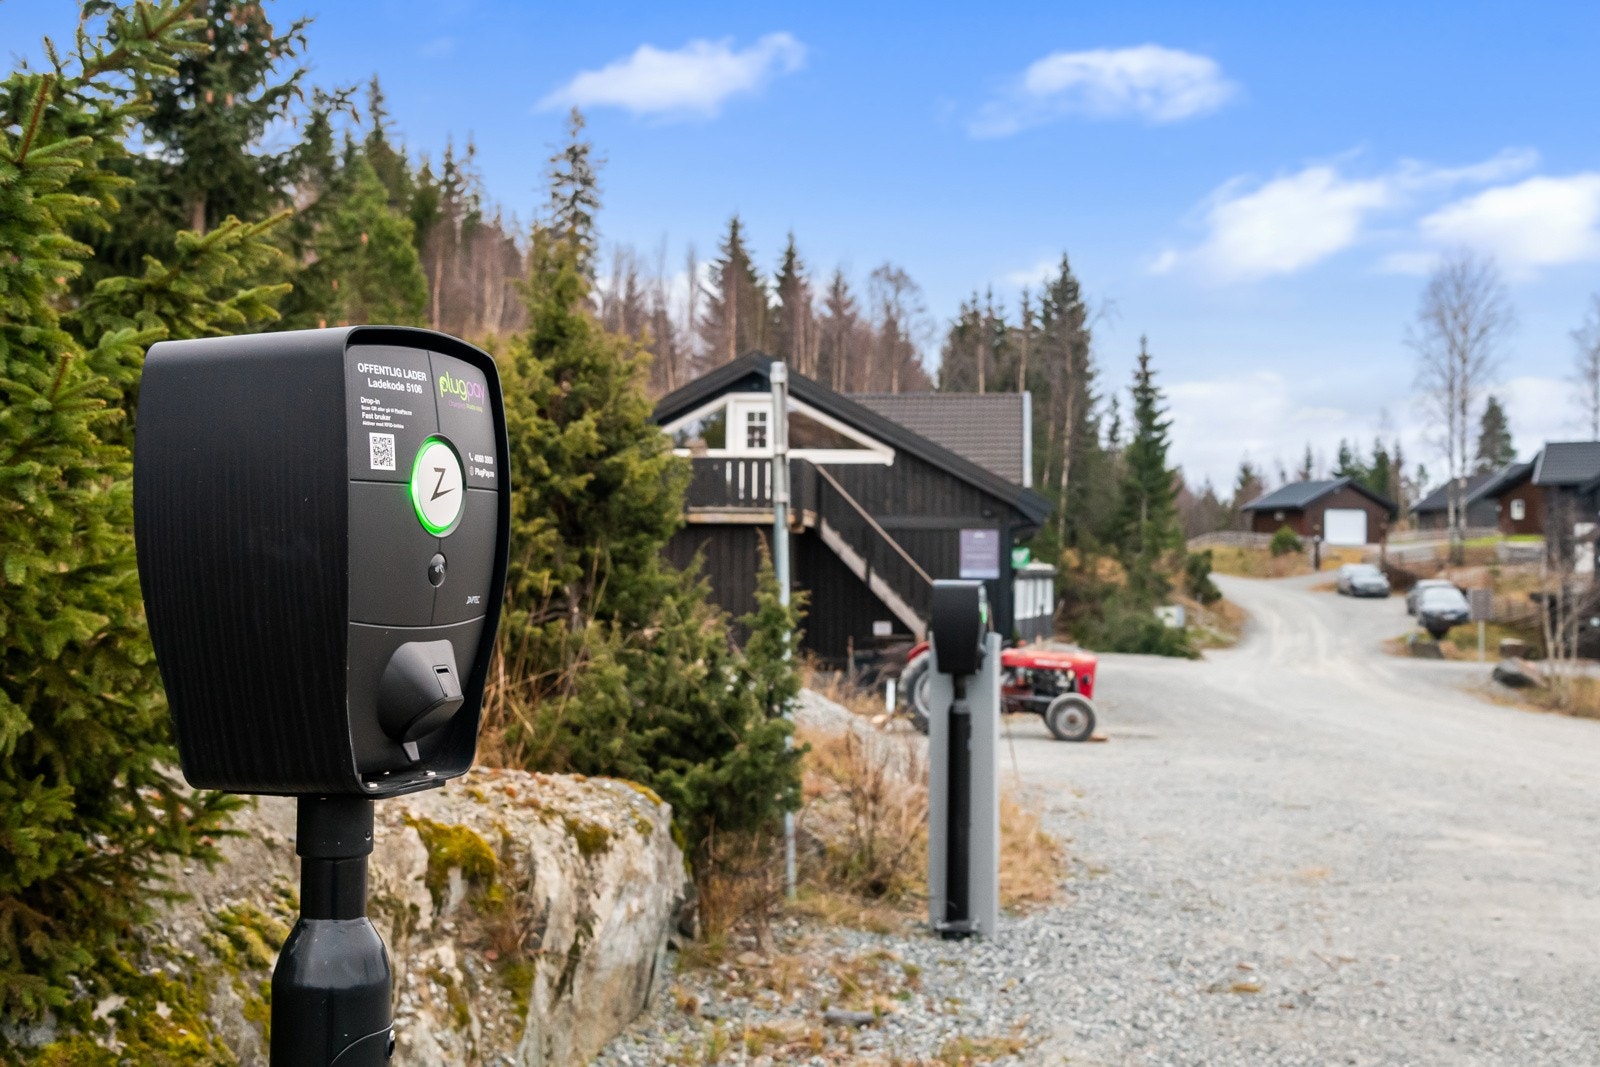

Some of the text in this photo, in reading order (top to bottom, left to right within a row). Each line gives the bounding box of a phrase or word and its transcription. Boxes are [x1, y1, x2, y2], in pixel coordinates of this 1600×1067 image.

[357, 362, 428, 382] OFFENTLIG LADER
[367, 377, 423, 394] Ladekode 5106
[360, 396, 381, 405] Drop-in
